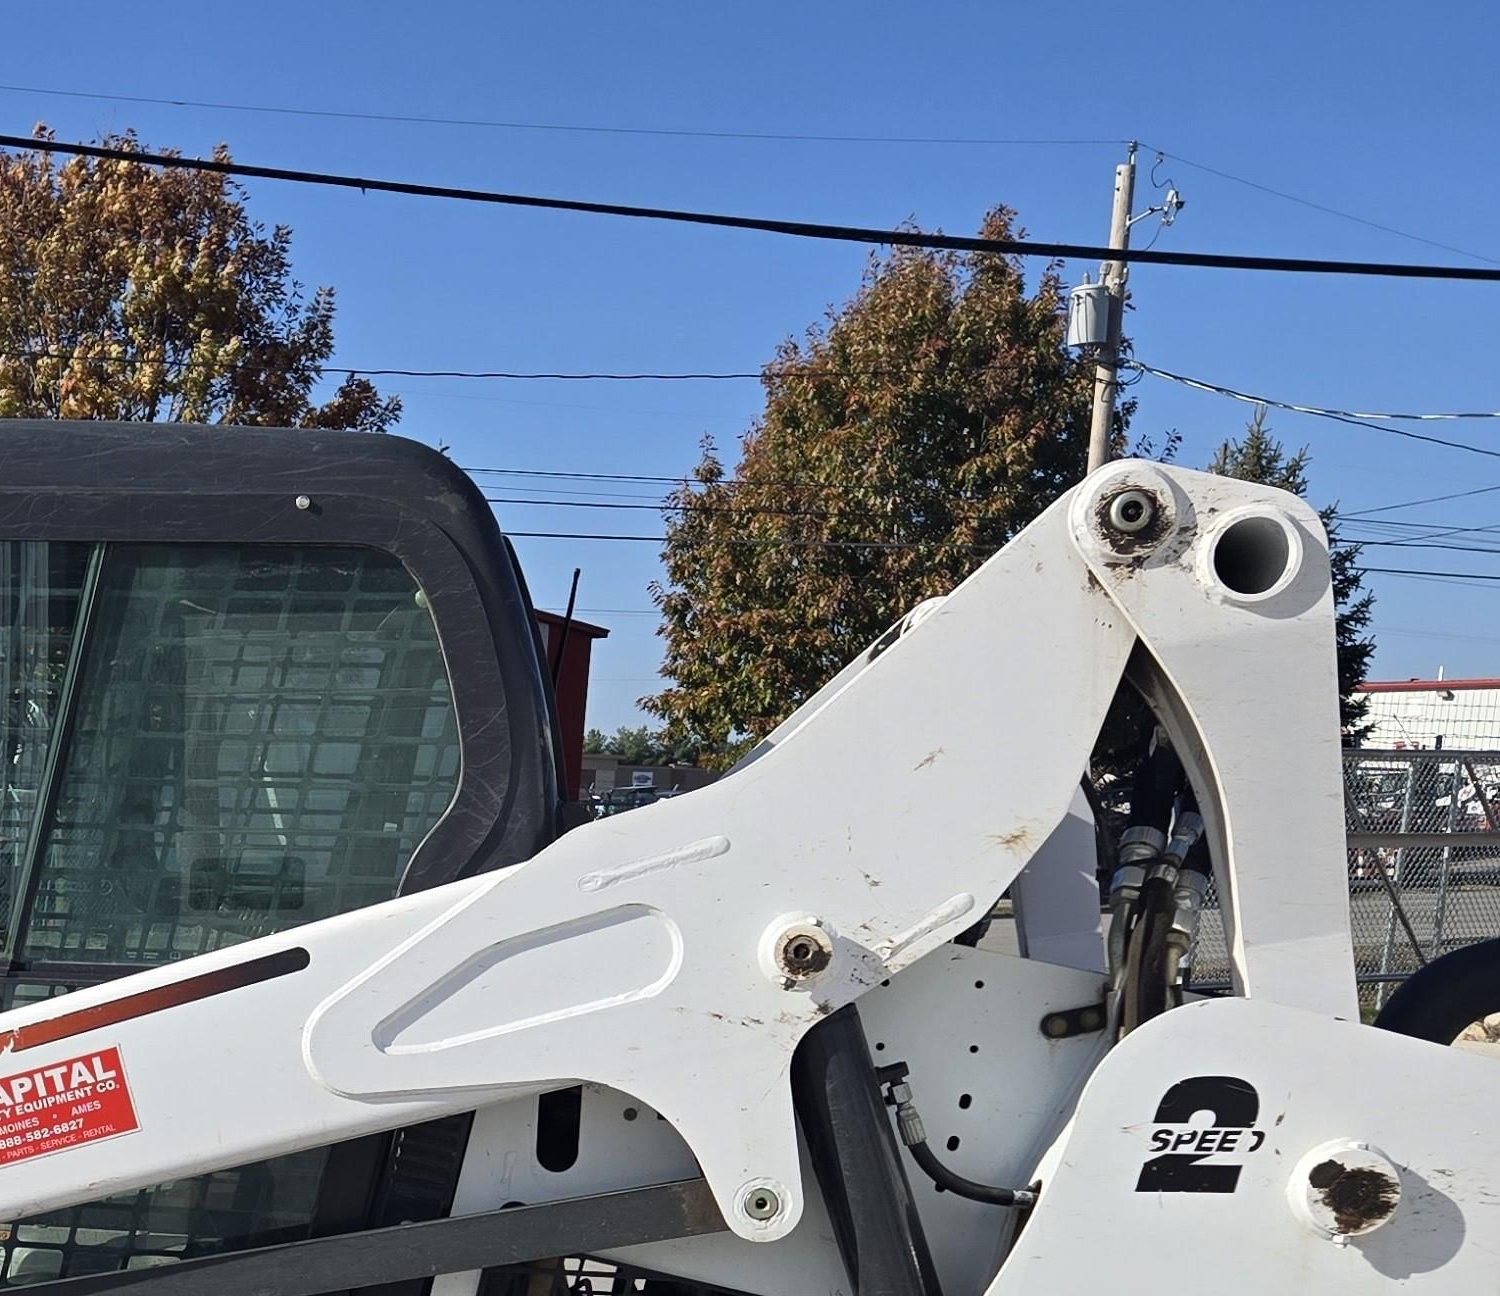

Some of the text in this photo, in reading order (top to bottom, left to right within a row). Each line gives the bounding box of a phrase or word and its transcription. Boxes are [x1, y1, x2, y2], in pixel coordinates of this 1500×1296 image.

[15, 1087, 92, 1116] EQUIPMENT
[96, 1081, 120, 1094] CO.
[71, 1100, 102, 1117] AMES
[7, 1146, 35, 1160] PARTS
[41, 1134, 77, 1151] SERVICE
[83, 1124, 117, 1139] RENTAL
[1135, 1075, 1260, 1194] 2
